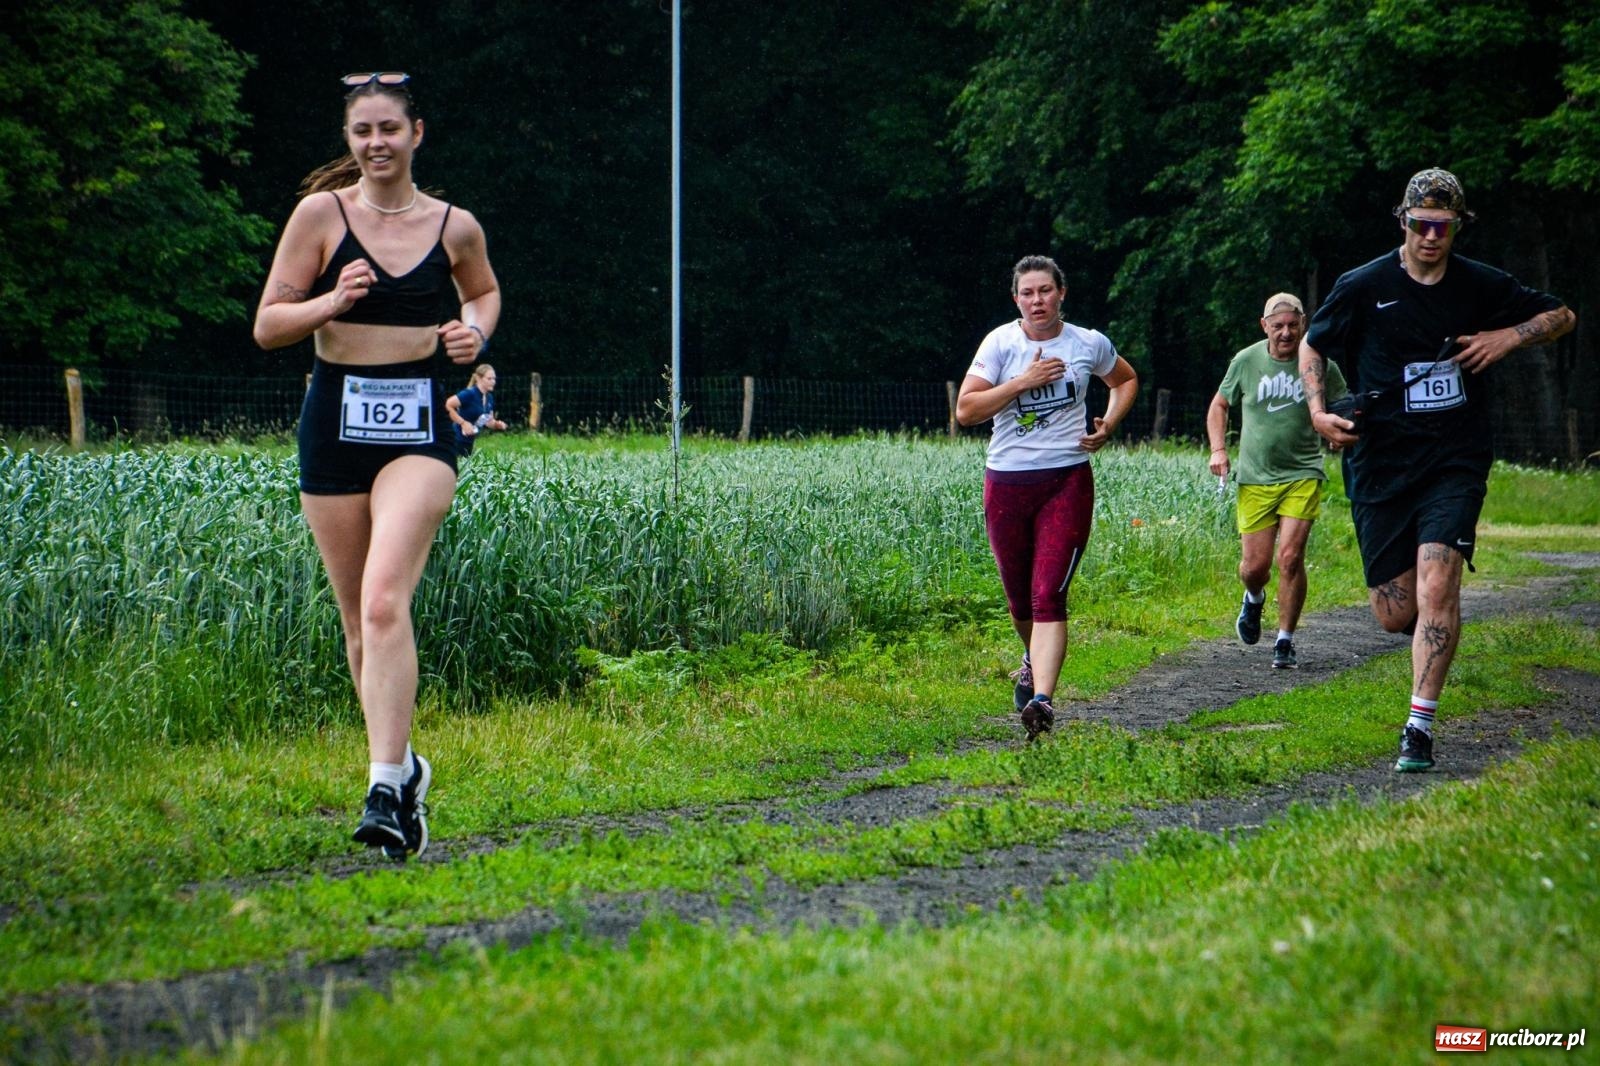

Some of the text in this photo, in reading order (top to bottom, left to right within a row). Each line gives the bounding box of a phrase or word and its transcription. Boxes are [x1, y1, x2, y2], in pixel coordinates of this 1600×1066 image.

[1031, 383, 1055, 400] 011
[1423, 378, 1451, 397] 161
[361, 402, 405, 424] 162
